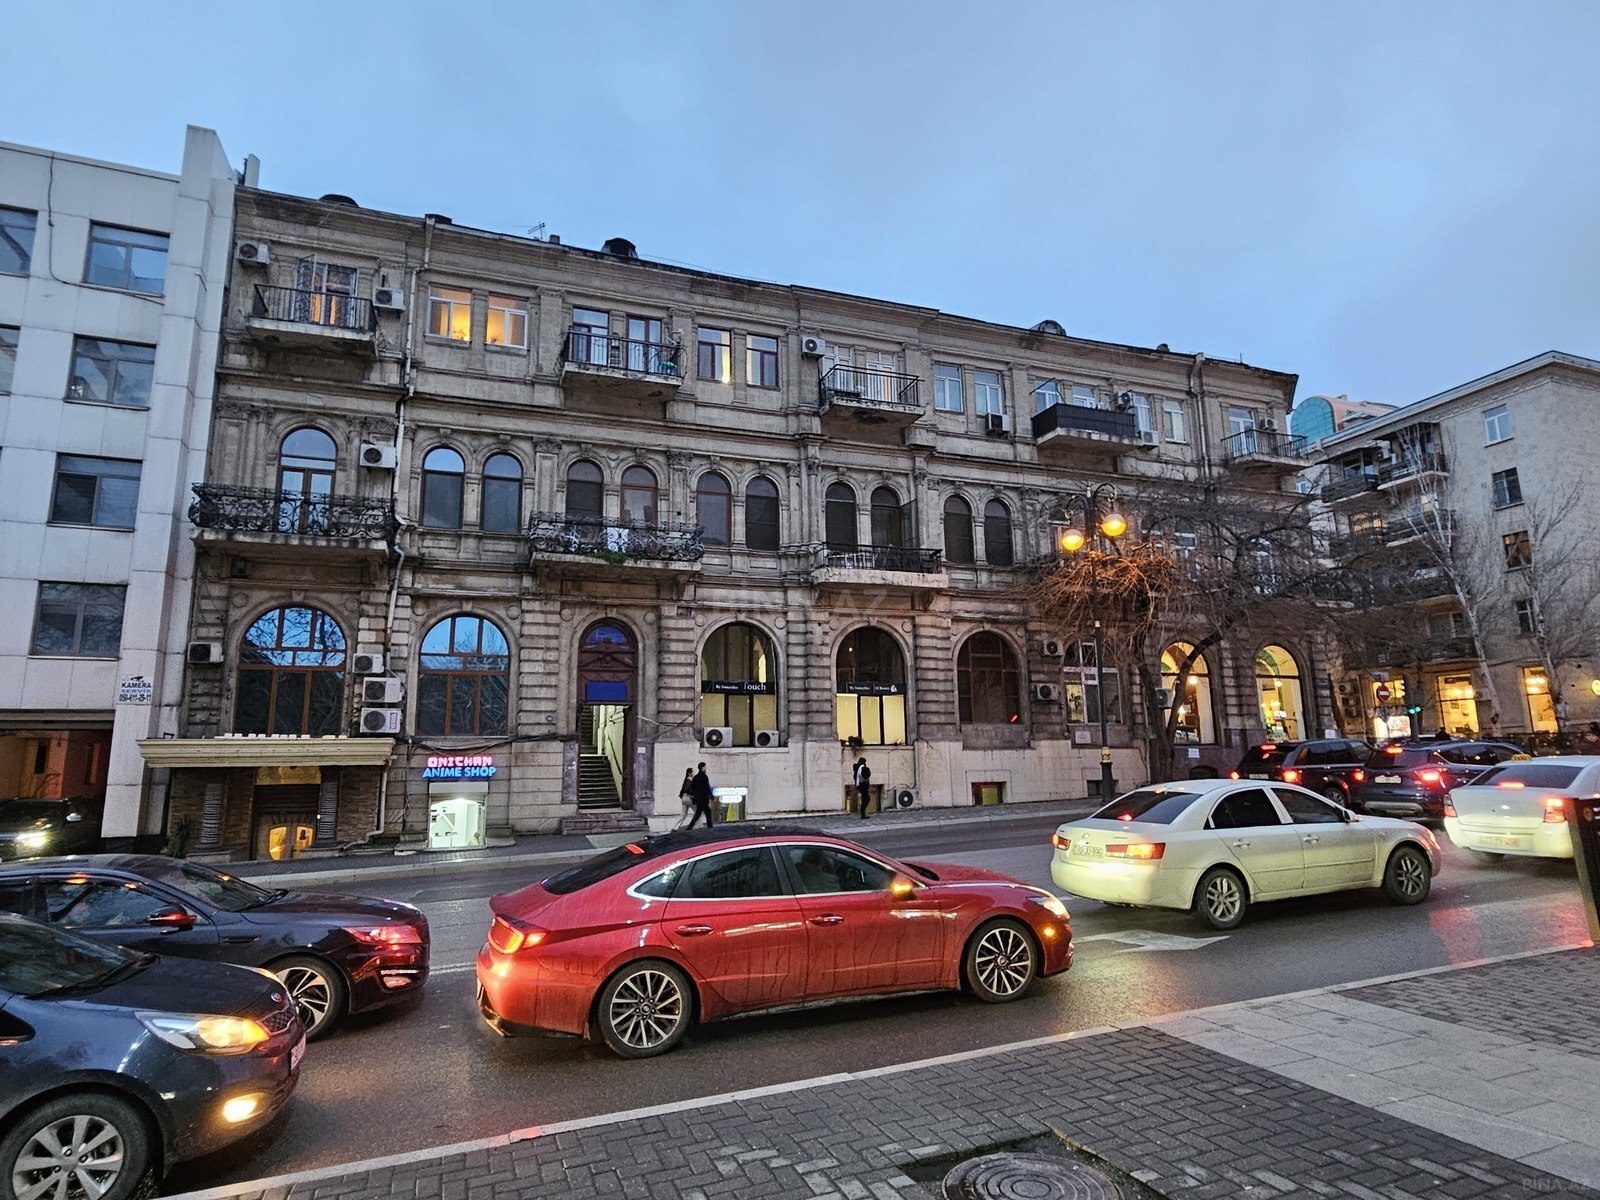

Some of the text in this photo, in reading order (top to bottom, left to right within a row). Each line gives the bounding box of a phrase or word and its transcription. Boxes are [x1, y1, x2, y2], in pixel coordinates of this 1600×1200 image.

[427, 756, 493, 768] ONICHAN
[422, 766, 497, 778] ANIME SHOP
